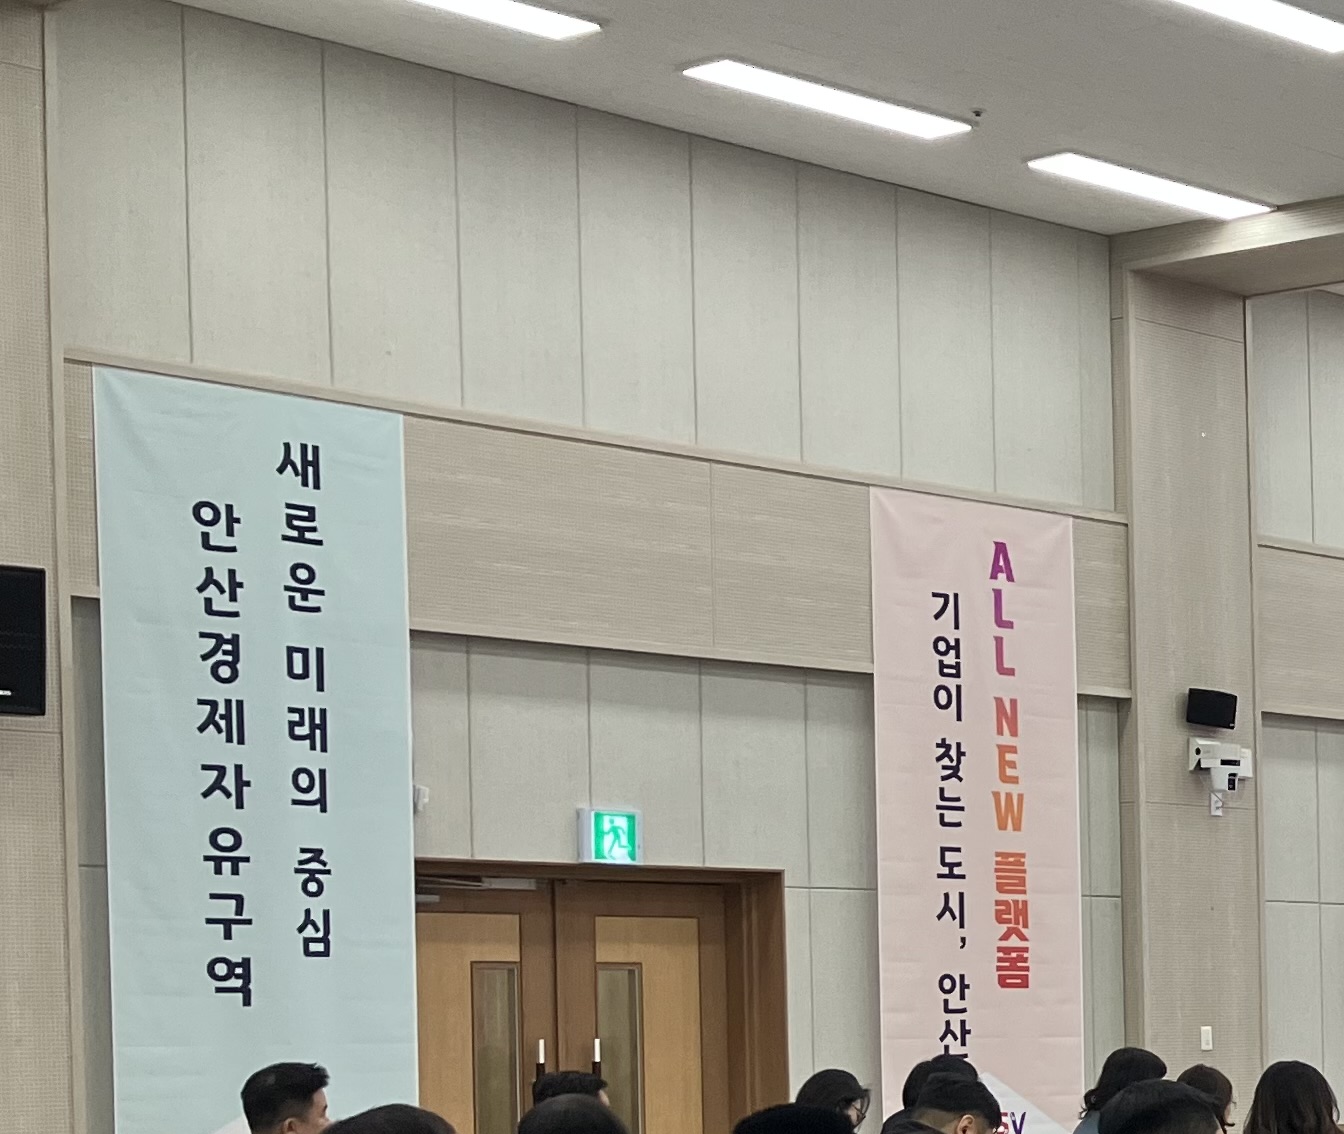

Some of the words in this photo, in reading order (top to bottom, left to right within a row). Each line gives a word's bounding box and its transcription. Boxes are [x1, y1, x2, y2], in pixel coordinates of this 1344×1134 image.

[276, 442, 325, 613] 새로운
[932, 591, 962, 722] 기업이
[989, 541, 1015, 676] ALL
[193, 501, 252, 1006] 안산경제자유구역
[286, 646, 329, 814] 미래의
[936, 738, 967, 828] 찾는
[992, 697, 1024, 832] NEW
[294, 848, 331, 957] 중심
[936, 847, 967, 950] 도시,
[994, 852, 1030, 989] 플랫폼
[938, 973, 971, 1055] 안산
